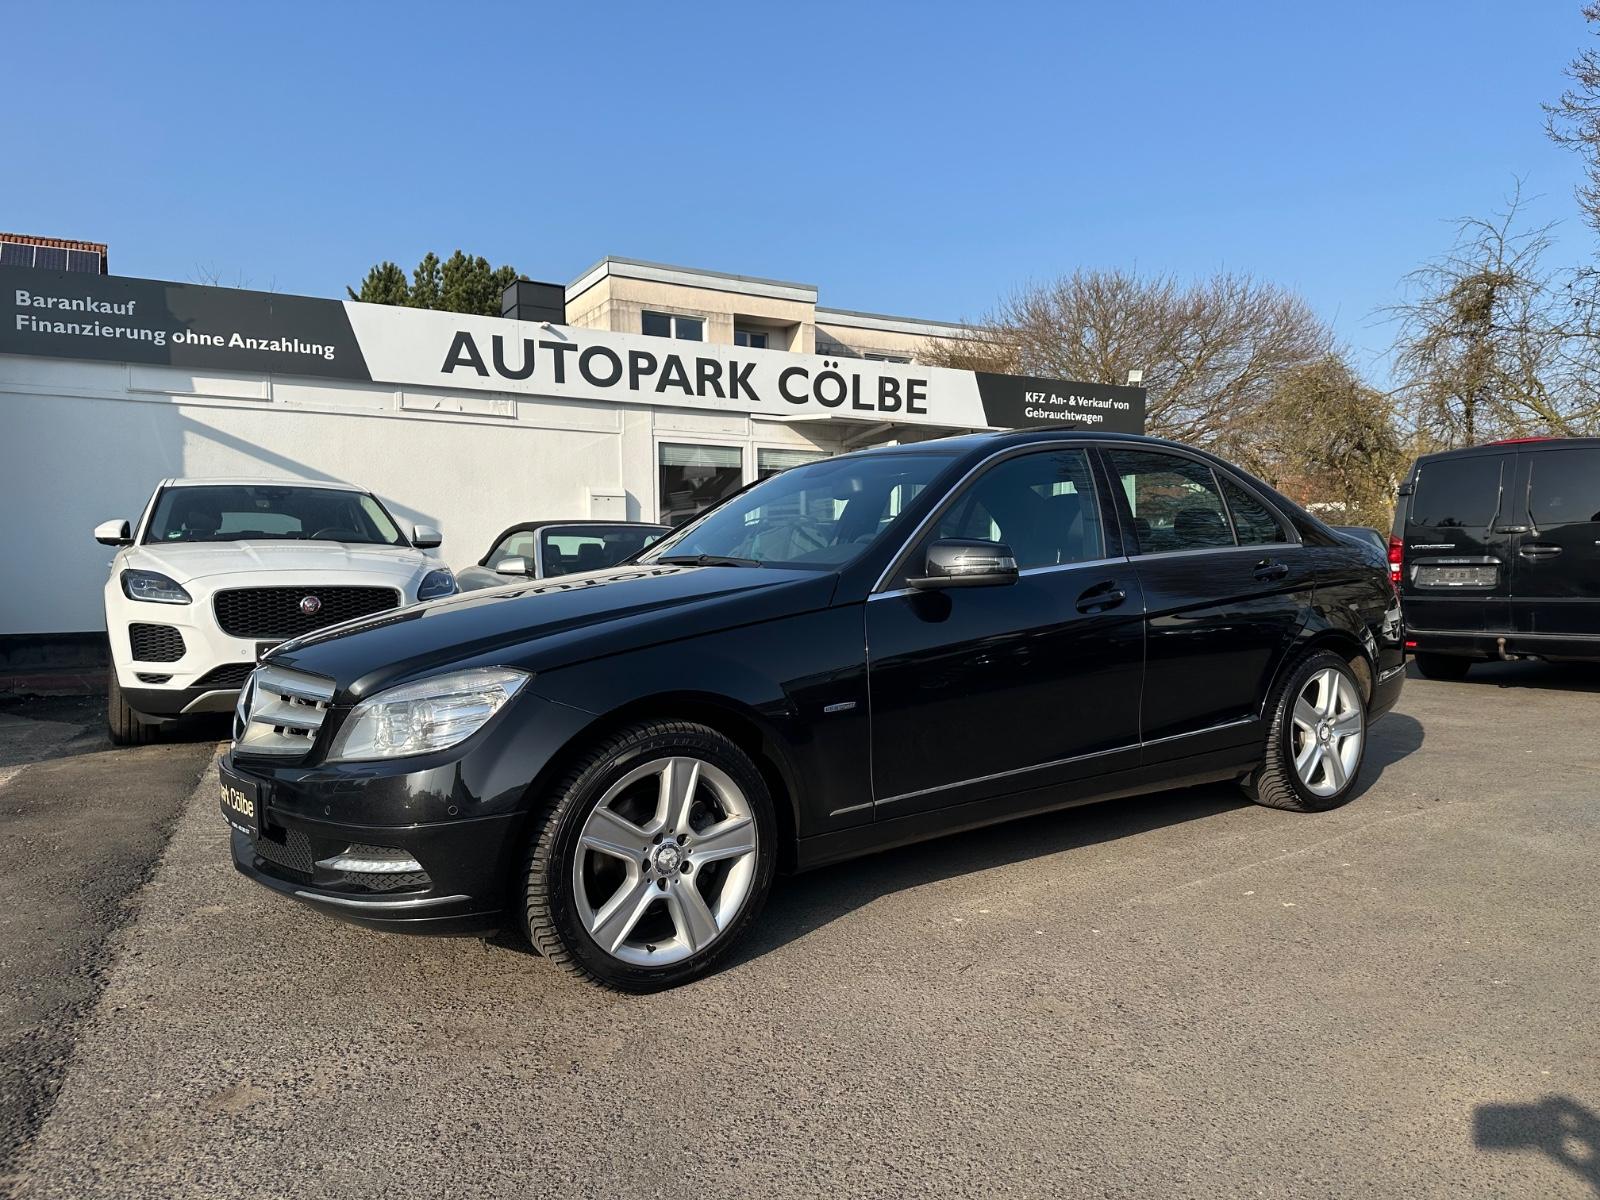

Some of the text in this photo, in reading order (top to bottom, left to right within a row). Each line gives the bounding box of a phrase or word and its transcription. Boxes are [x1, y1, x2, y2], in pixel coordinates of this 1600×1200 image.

[15, 289, 136, 316] Barankauf
[15, 314, 335, 359] Finanzierung ohne Anzahlung
[441, 331, 928, 415] AUTOPARK CÖLBE
[1025, 391, 1130, 410] KFZ An- & Verkauf von
[1024, 407, 1103, 425] Gebrauchtwagen
[230, 787, 254, 818] Cölbe
